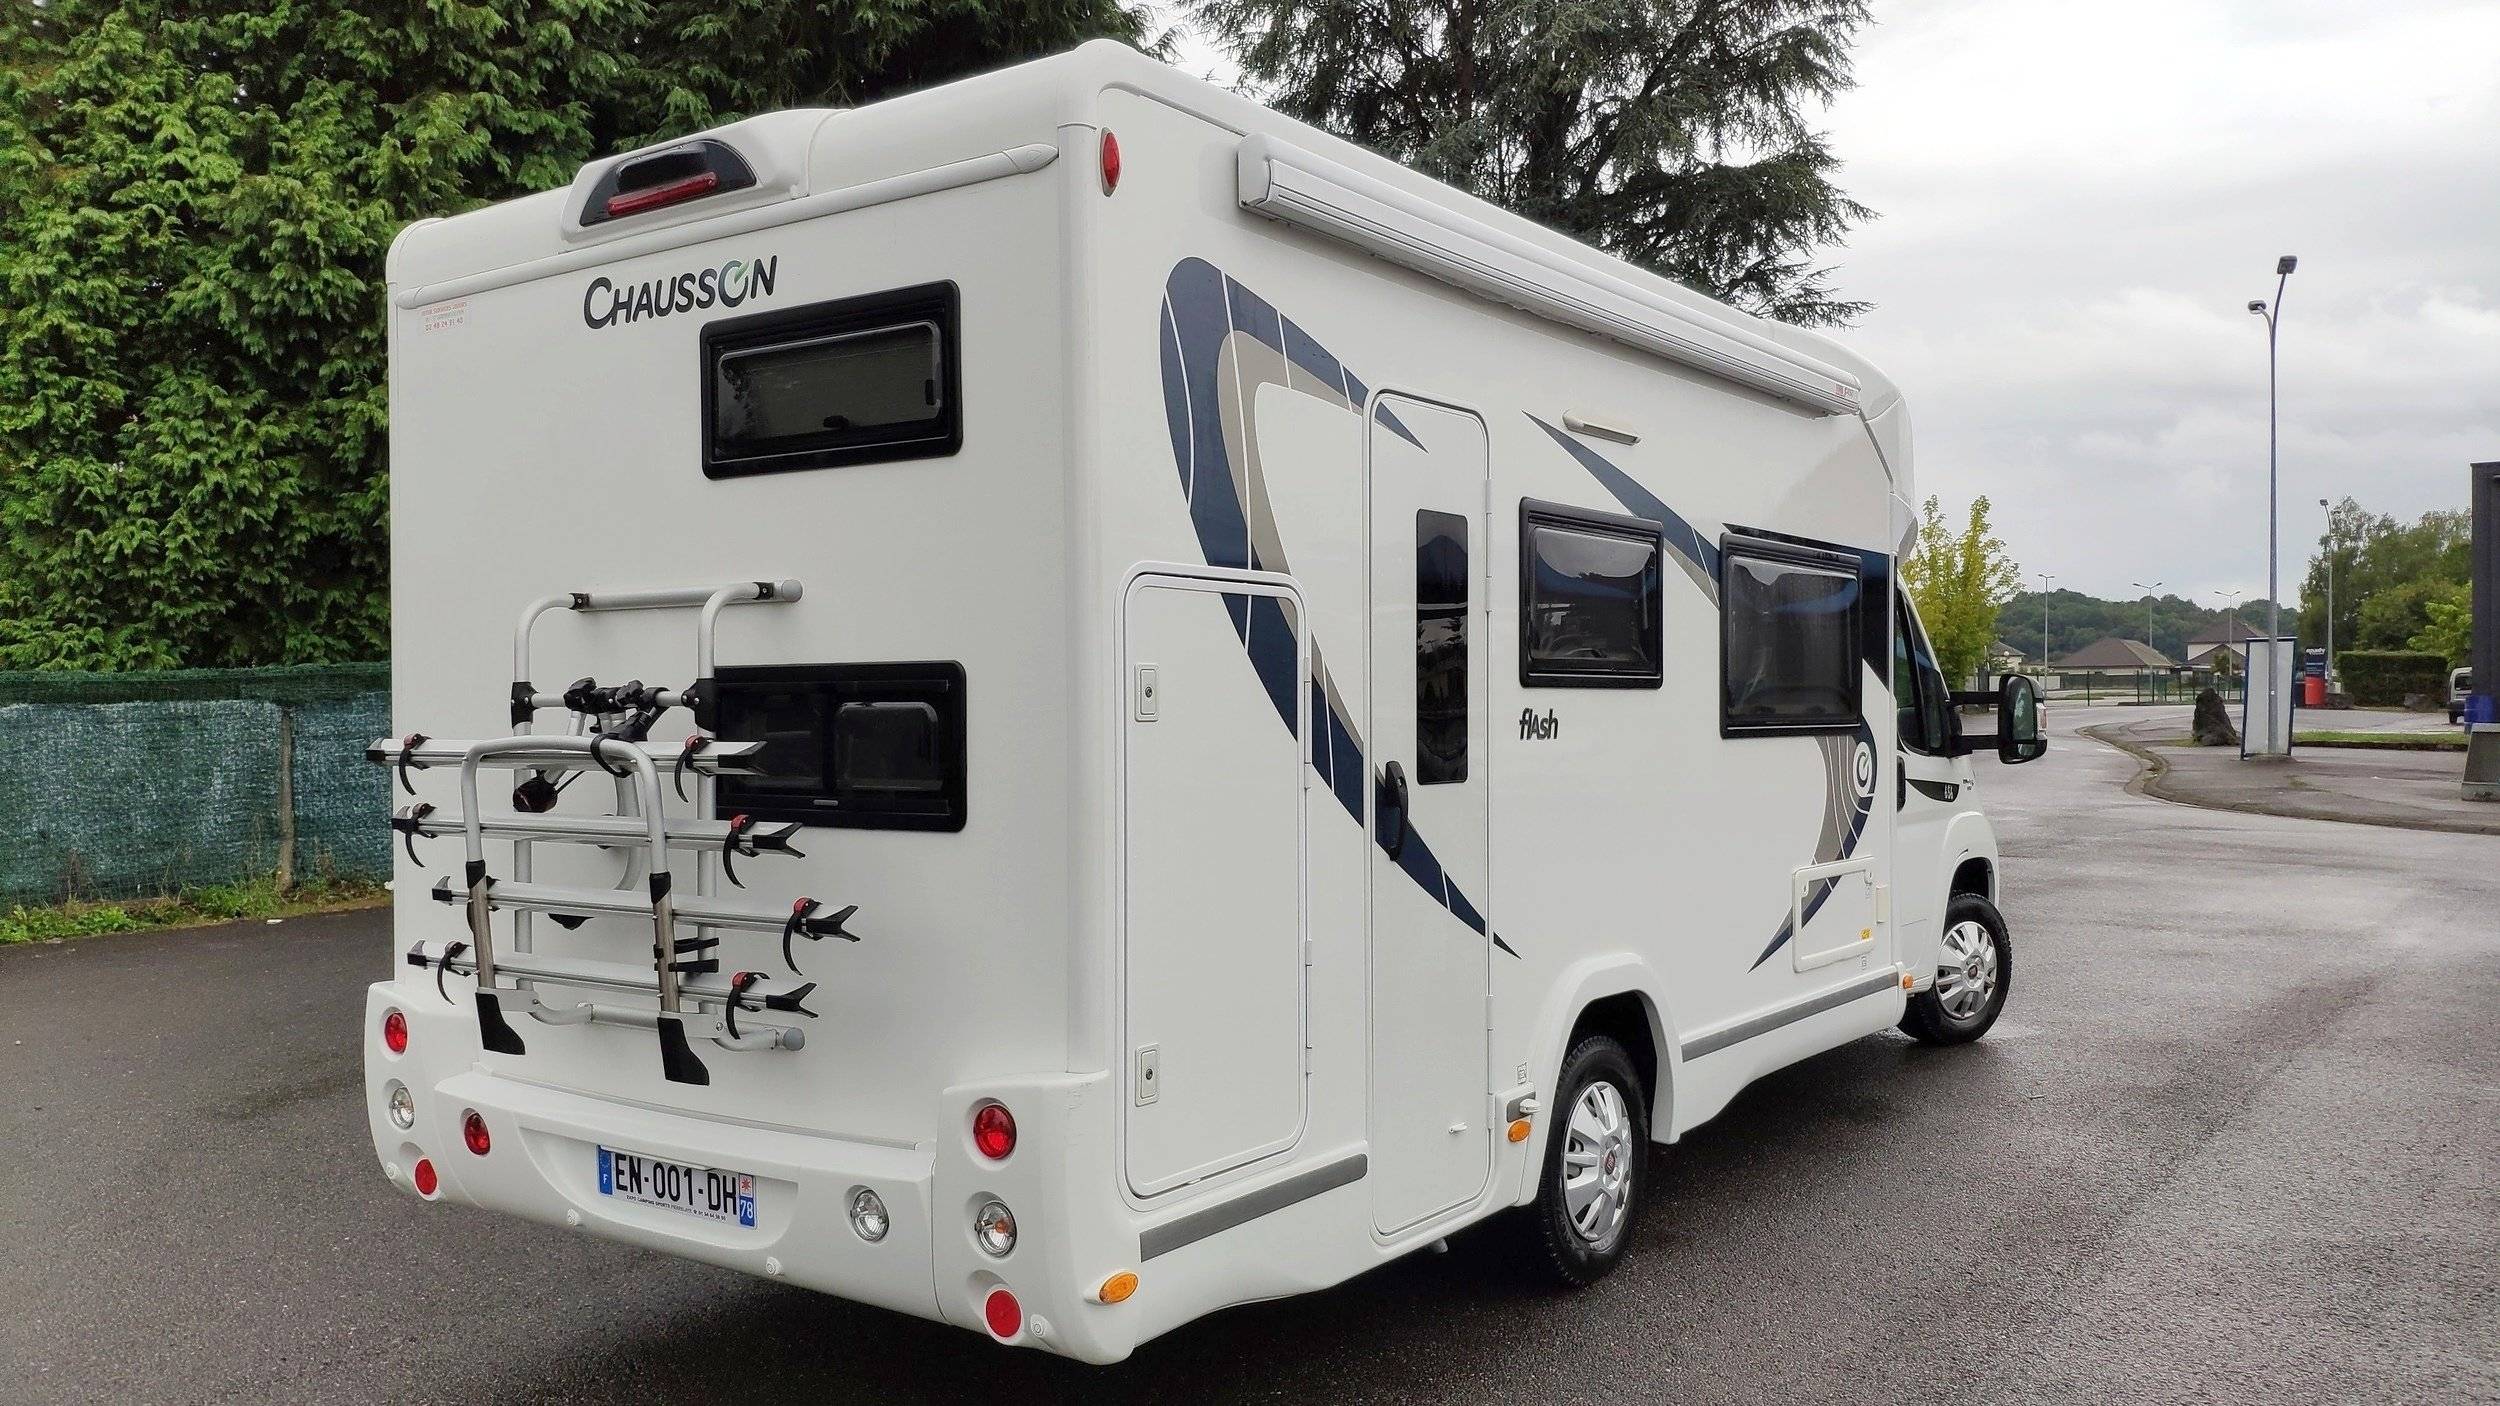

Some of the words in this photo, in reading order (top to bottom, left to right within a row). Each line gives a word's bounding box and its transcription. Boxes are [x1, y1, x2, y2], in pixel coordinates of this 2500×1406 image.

[583, 254, 778, 330] CHAUSSON
[602, 1173, 608, 1184] F
[740, 1199, 754, 1219] 78
